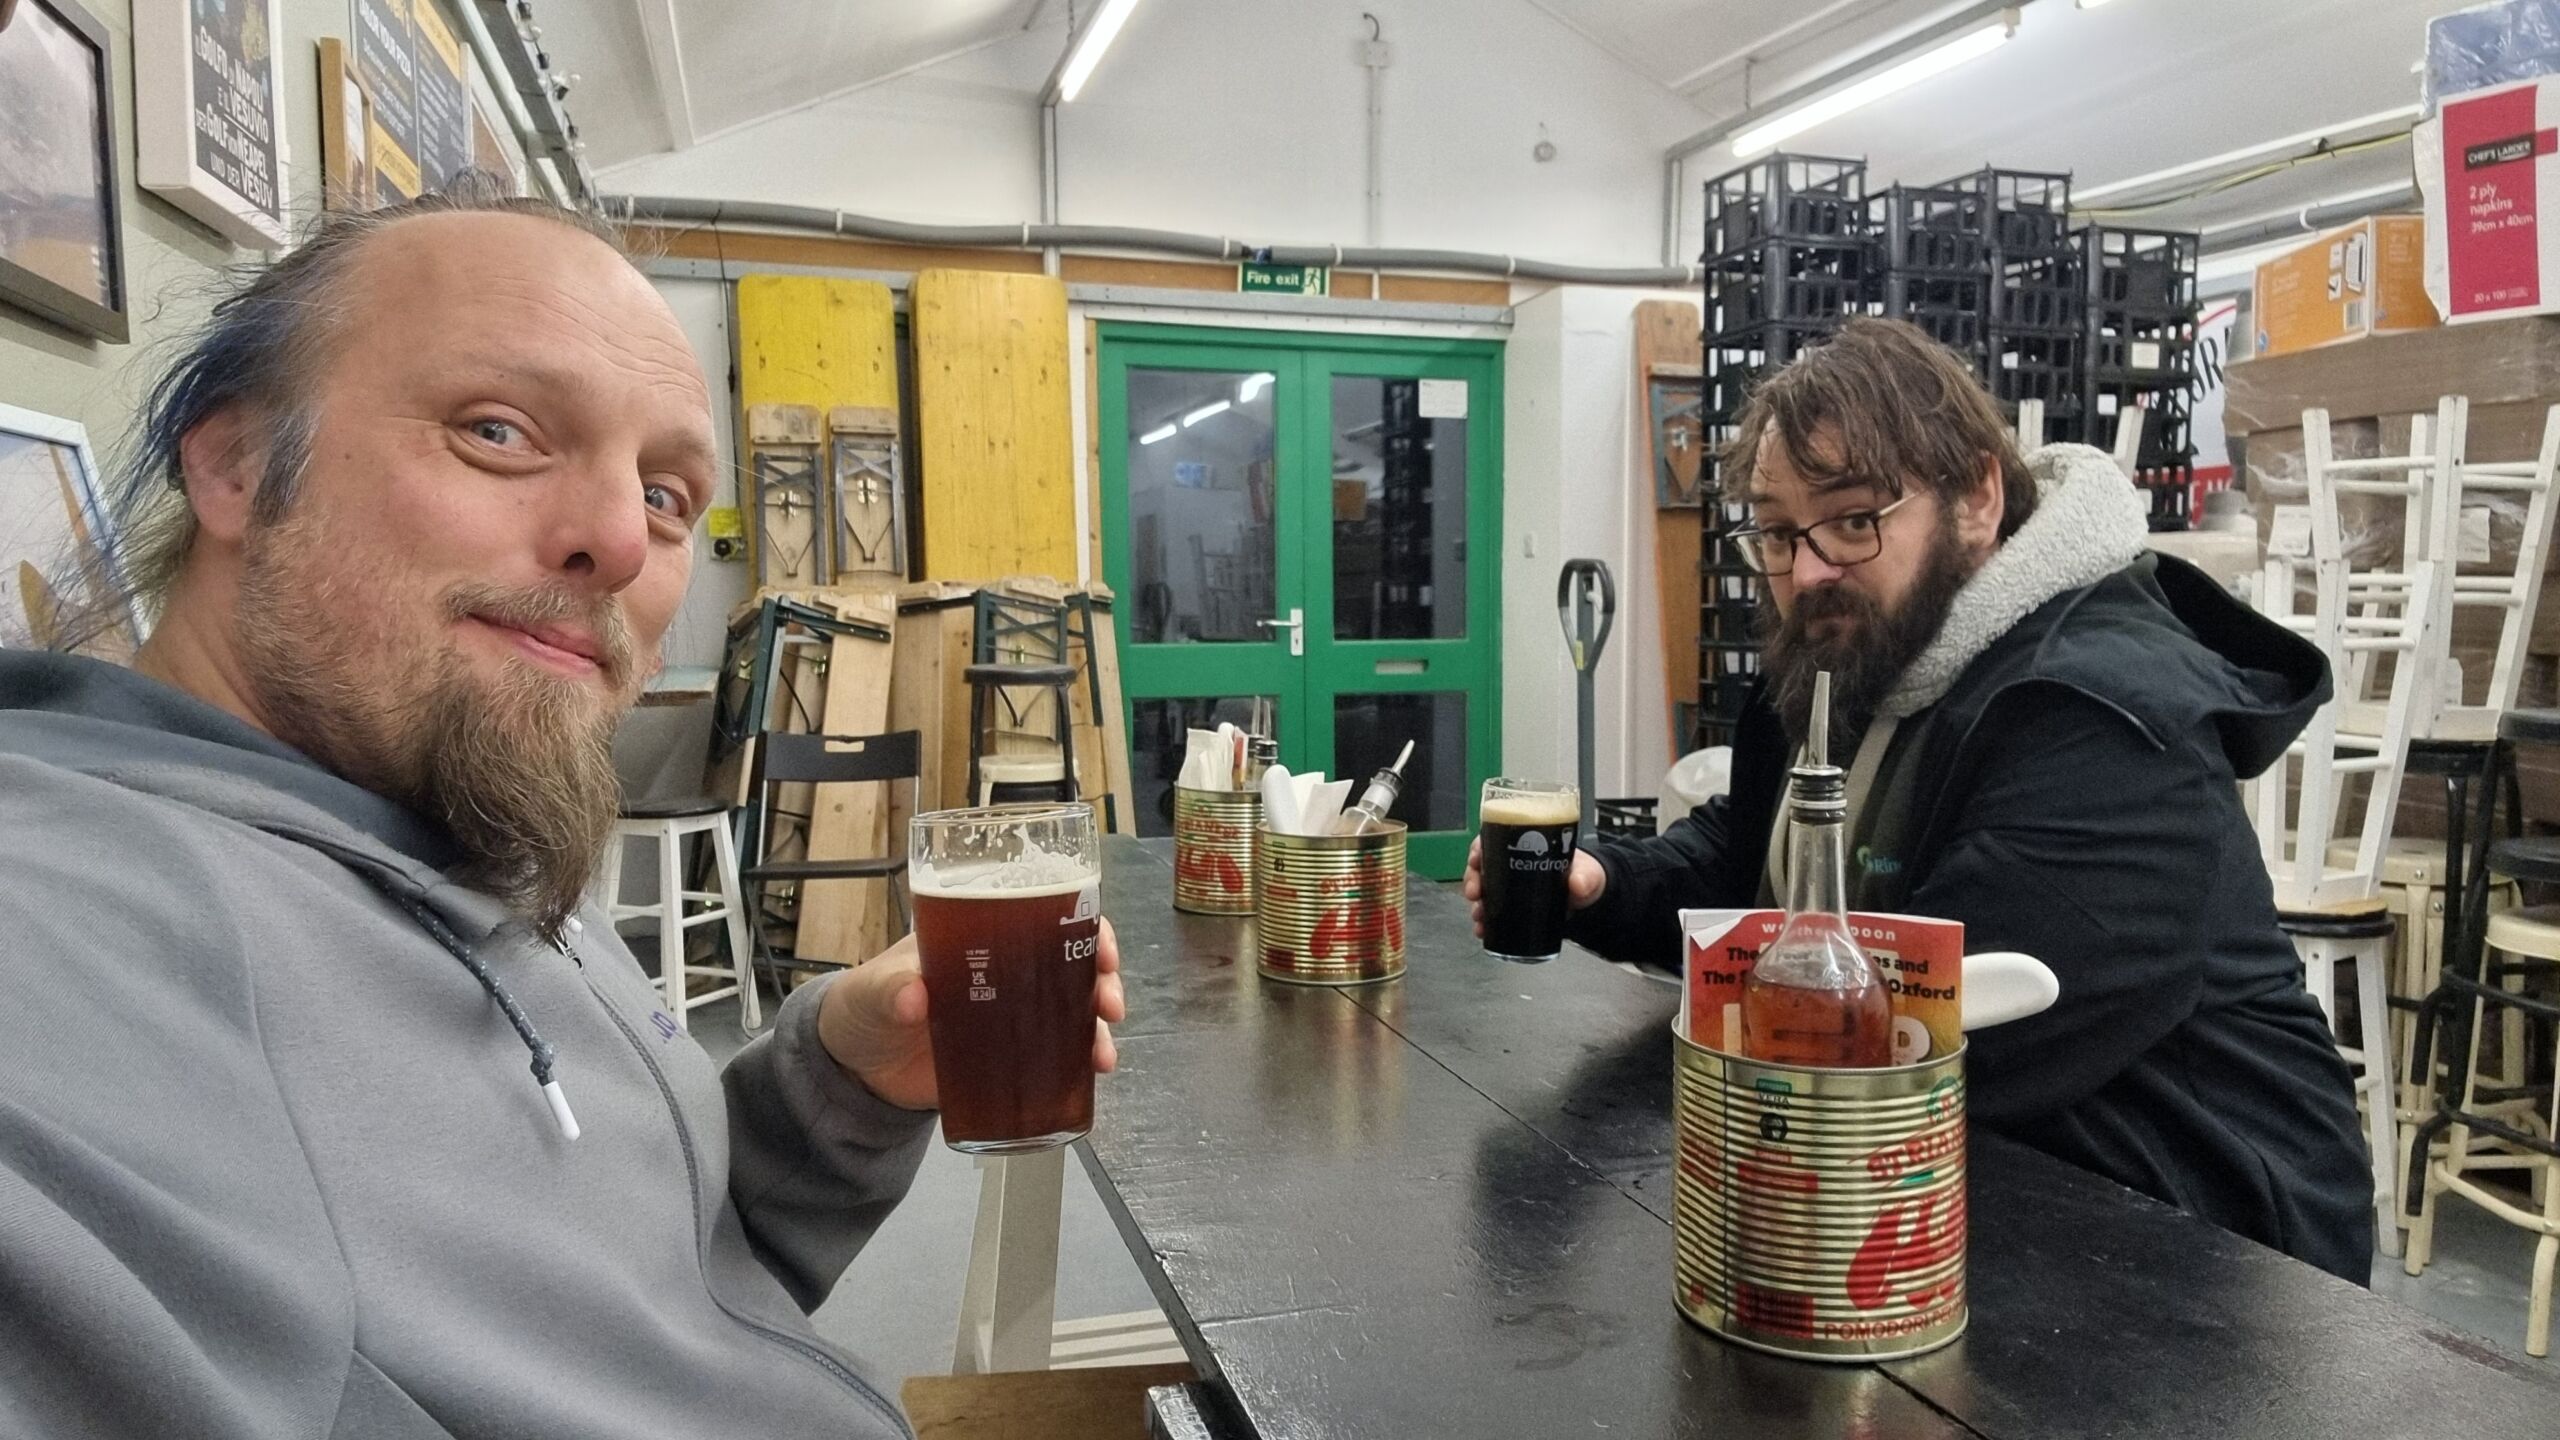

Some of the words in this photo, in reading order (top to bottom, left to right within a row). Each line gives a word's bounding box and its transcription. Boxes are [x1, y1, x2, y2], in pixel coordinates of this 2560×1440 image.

[200, 25, 227, 79] GOLFO
[235, 58, 263, 112] NAPOLI
[229, 85, 269, 144] VESUVIO
[206, 102, 228, 148] GOLF
[237, 129, 268, 181] NEAPEL
[2467, 149, 2496, 164] CHEF'S
[2497, 140, 2531, 157] LARDER
[240, 162, 272, 209] VESUV
[2469, 185, 2476, 199] 2
[2479, 183, 2497, 199] ply
[2470, 198, 2513, 217] napkins
[2506, 212, 2534, 227] 40cm
[1246, 270, 1271, 285] Fire
[1276, 273, 1299, 286] exit
[1509, 857, 1569, 873] teardrop
[1727, 947, 1760, 961] The
[1893, 958, 1930, 975] and
[972, 971, 984, 979] UK
[1702, 971, 1736, 985] The
[1888, 978, 1955, 1000] Oxford
